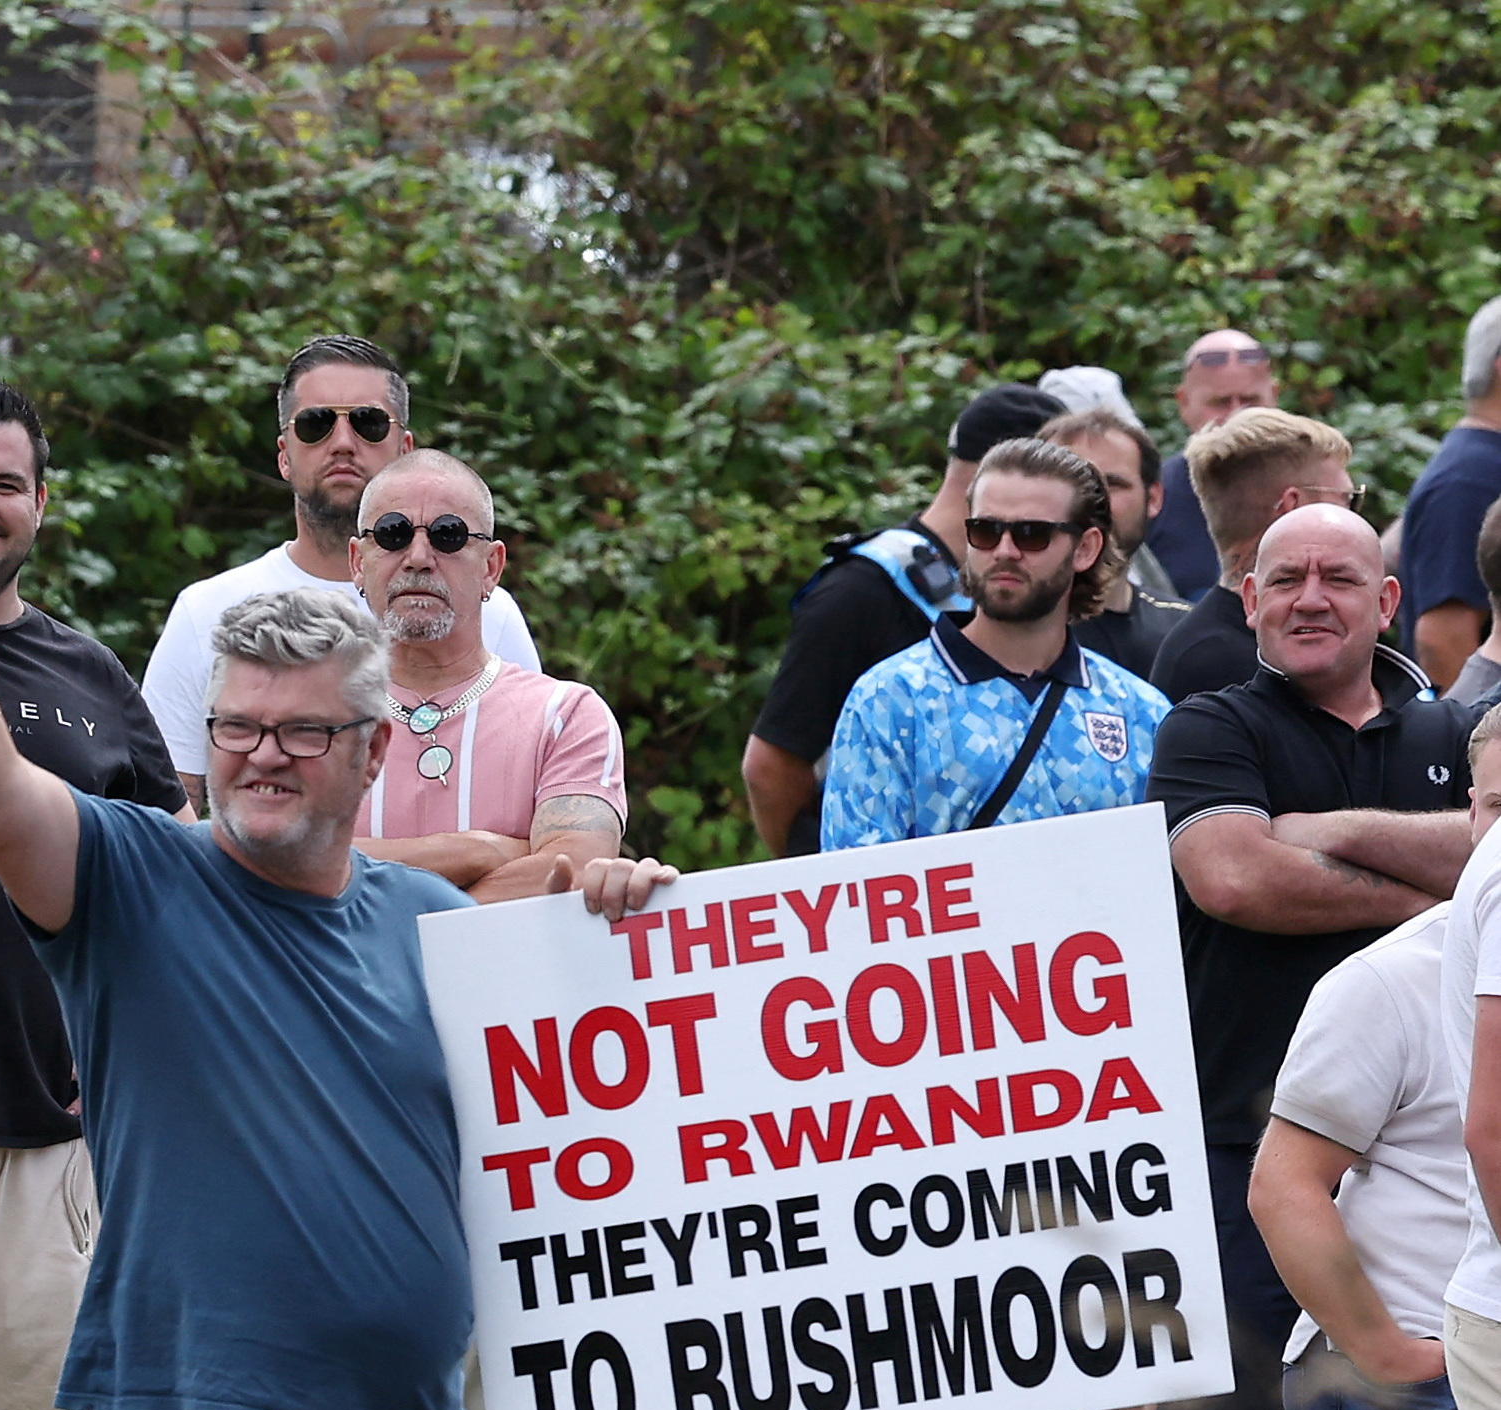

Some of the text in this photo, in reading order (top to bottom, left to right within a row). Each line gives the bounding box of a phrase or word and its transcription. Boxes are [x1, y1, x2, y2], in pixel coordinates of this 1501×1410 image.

[610, 862, 981, 981] THEY'RE
[484, 931, 1133, 1126] NOT GOING
[482, 1056, 1164, 1212] TO RWANDA
[498, 1141, 1174, 1312] THEY'RE COMING
